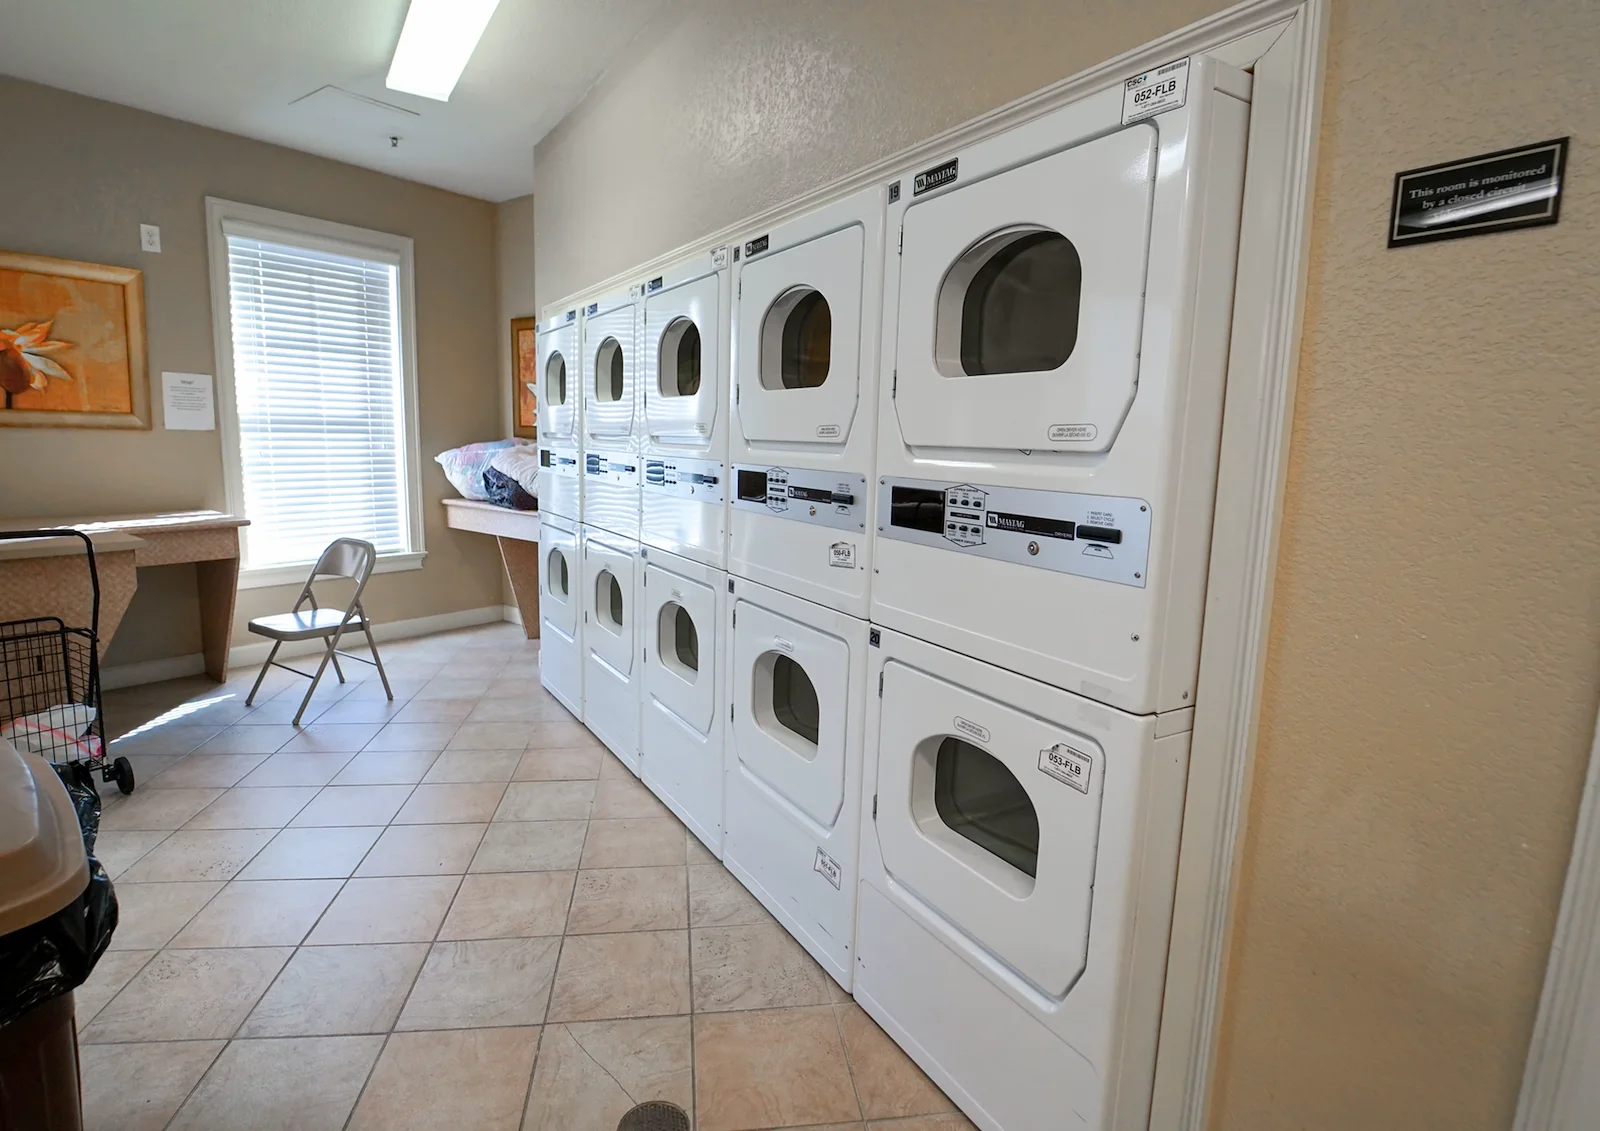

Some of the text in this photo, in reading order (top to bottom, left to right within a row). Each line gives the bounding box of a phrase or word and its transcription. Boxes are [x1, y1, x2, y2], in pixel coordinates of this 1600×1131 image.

[1134, 80, 1176, 103] 052-FLB
[926, 165, 956, 185] MAYTAG
[1409, 164, 1546, 199] This room is monitored
[890, 185, 899, 199] 19
[1422, 200, 1436, 210] by
[1447, 189, 1484, 204] closed
[1486, 183, 1527, 197] circuit
[999, 517, 1025, 528] MAYTAG
[871, 632, 880, 644] 20
[1049, 752, 1081, 775] 053-FLB
